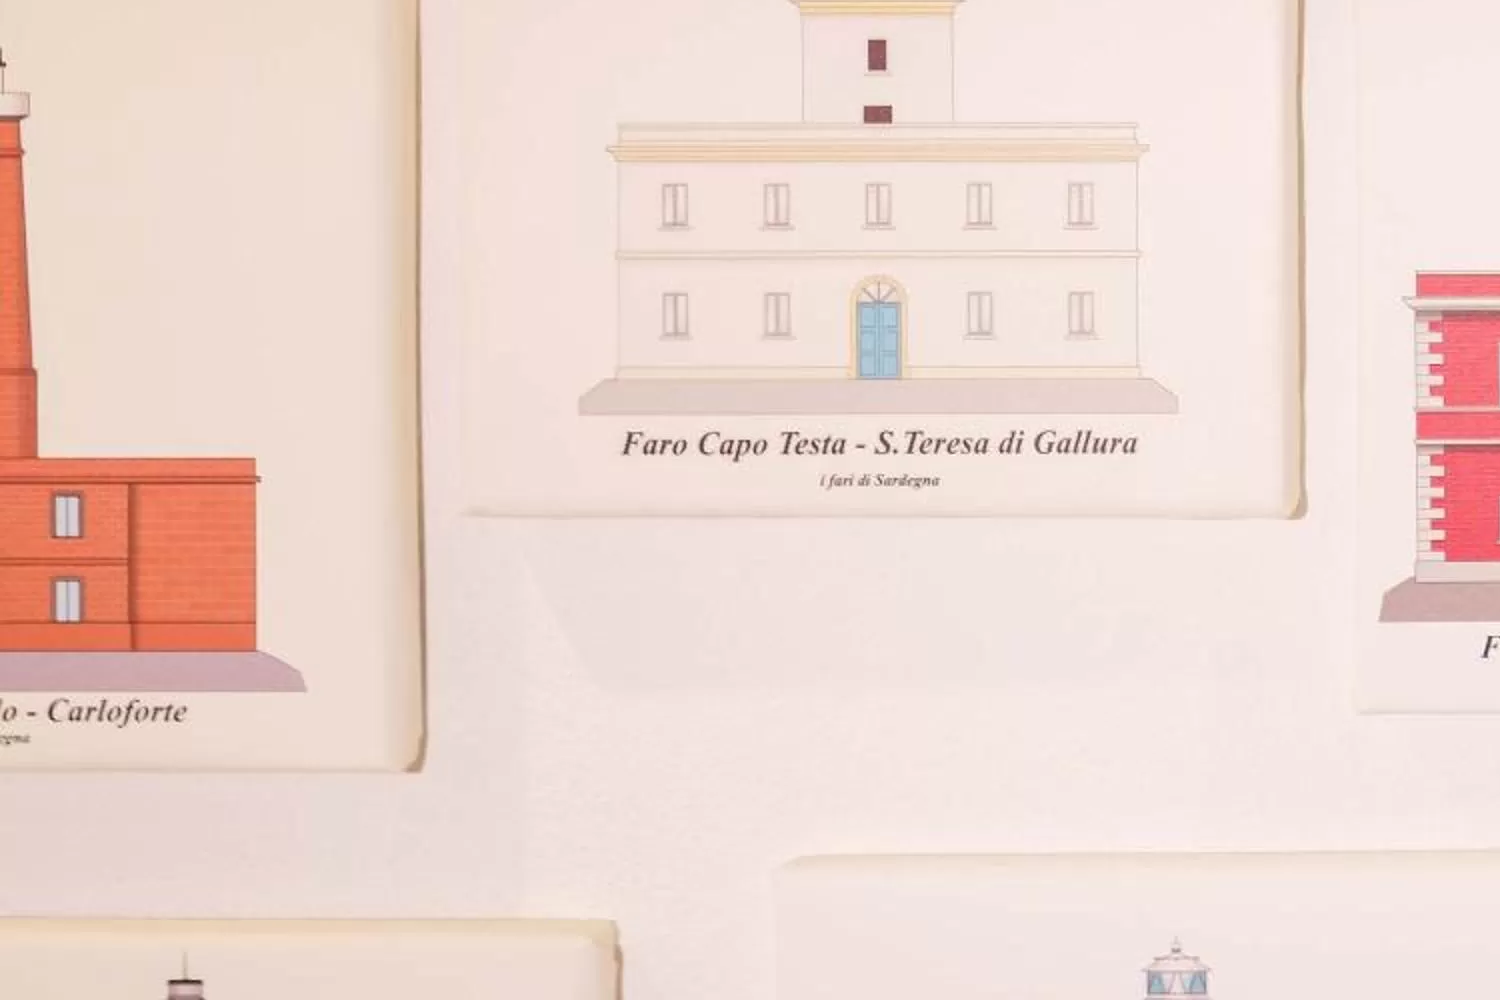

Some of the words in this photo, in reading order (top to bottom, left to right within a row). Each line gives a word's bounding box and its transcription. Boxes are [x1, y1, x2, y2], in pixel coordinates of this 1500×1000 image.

[621, 431, 689, 457] Faro
[697, 431, 769, 463] Capo
[780, 430, 847, 456] Testa
[997, 430, 1025, 455] di
[1033, 430, 1138, 455] Gallura
[826, 473, 854, 490] fari
[857, 473, 871, 487] di
[874, 473, 941, 489] Sardegna
[47, 699, 188, 728] Carloforte
